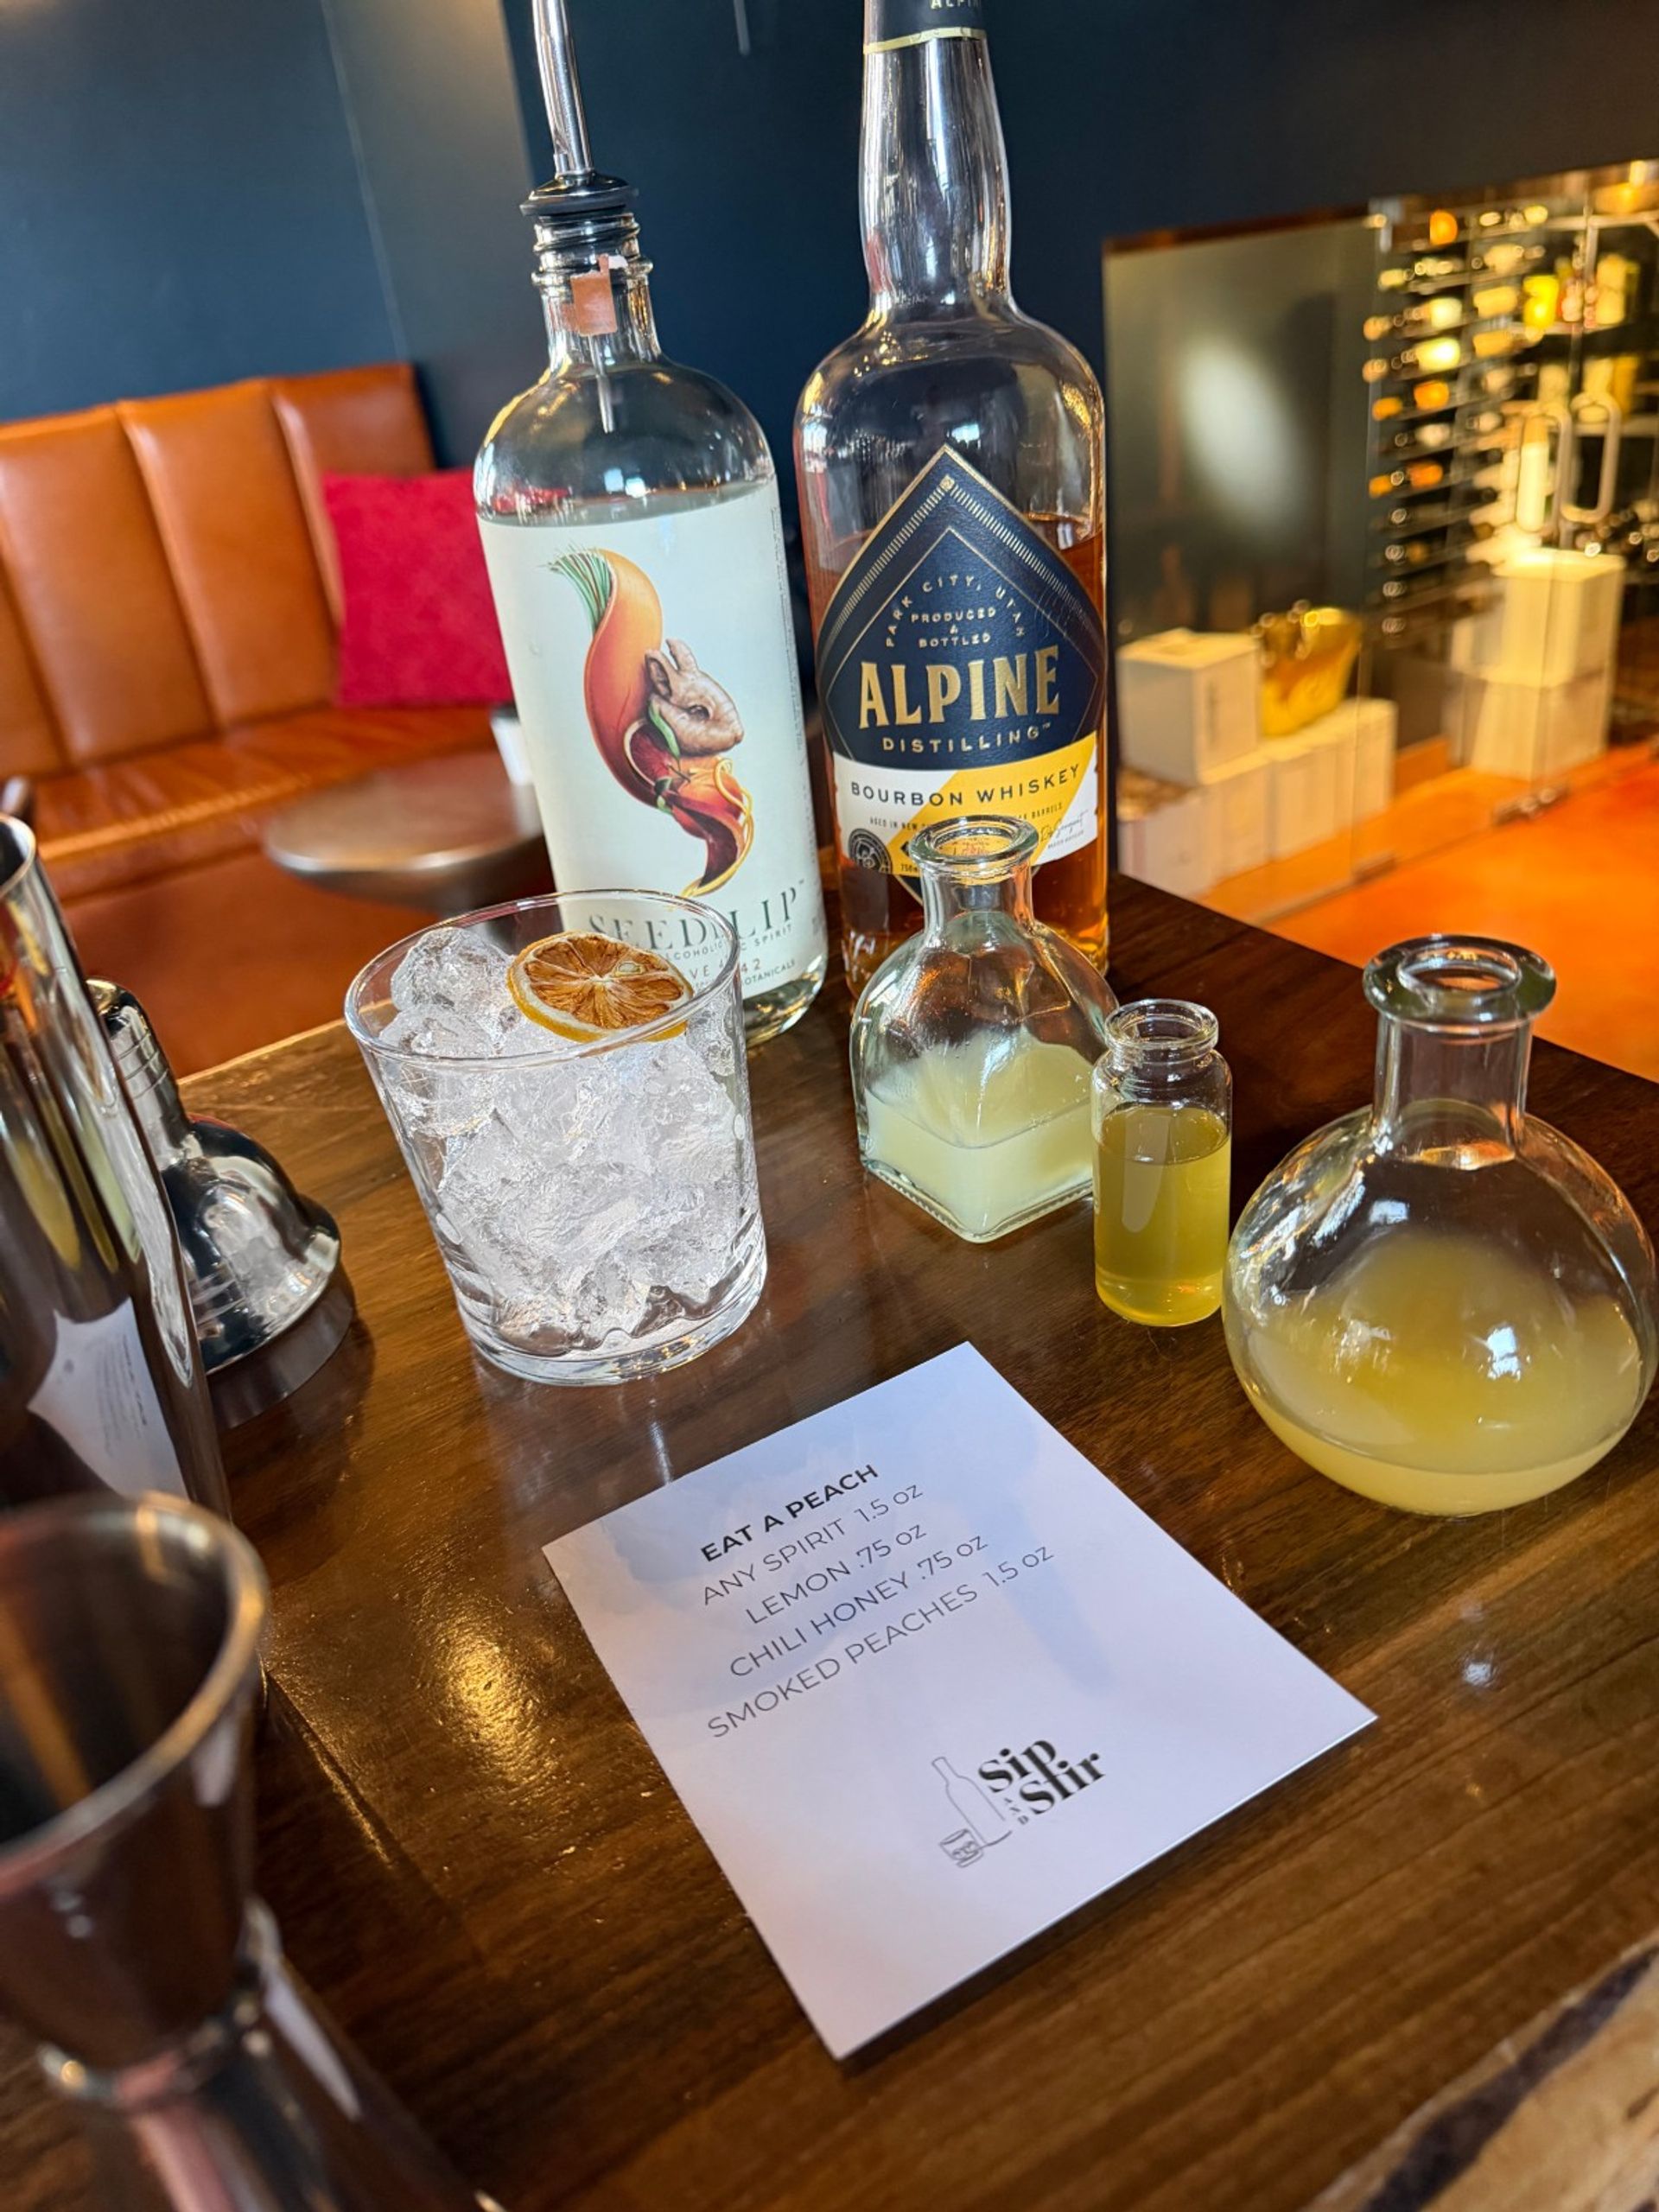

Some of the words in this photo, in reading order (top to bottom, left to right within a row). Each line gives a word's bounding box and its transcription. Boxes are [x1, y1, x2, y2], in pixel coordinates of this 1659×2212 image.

[886, 595, 912, 647] PARK
[911, 607, 996, 623] PRODUCED
[918, 632, 991, 648] BOTTLED
[859, 645, 1059, 729] ALPINE
[851, 780, 963, 806] BOURBON
[977, 763, 1080, 804] WHISKEY
[754, 925, 792, 946] SPIRIT
[742, 958, 796, 986] OTANICALS
[700, 1524, 755, 1562] EAT
[764, 1515, 785, 1533] A
[785, 1464, 880, 1519] PEACH
[702, 1564, 758, 1605] ANY
[762, 1517, 847, 1573] SPIRIT
[854, 1497, 890, 1522] 1.5
[893, 1484, 924, 1504] oz
[729, 1627, 808, 1677] CHILI
[810, 1571, 909, 1636] HONEY
[916, 1550, 953, 1580] .75
[956, 1535, 988, 1557] oz
[746, 1560, 851, 1624] LEMON
[855, 1538, 892, 1568] .75
[895, 1523, 927, 1546] oz
[707, 1656, 842, 1738] SMOKED
[844, 1584, 978, 1665] PEACHES
[982, 1560, 1020, 1588] 1.5
[1021, 1546, 1054, 1568] oz
